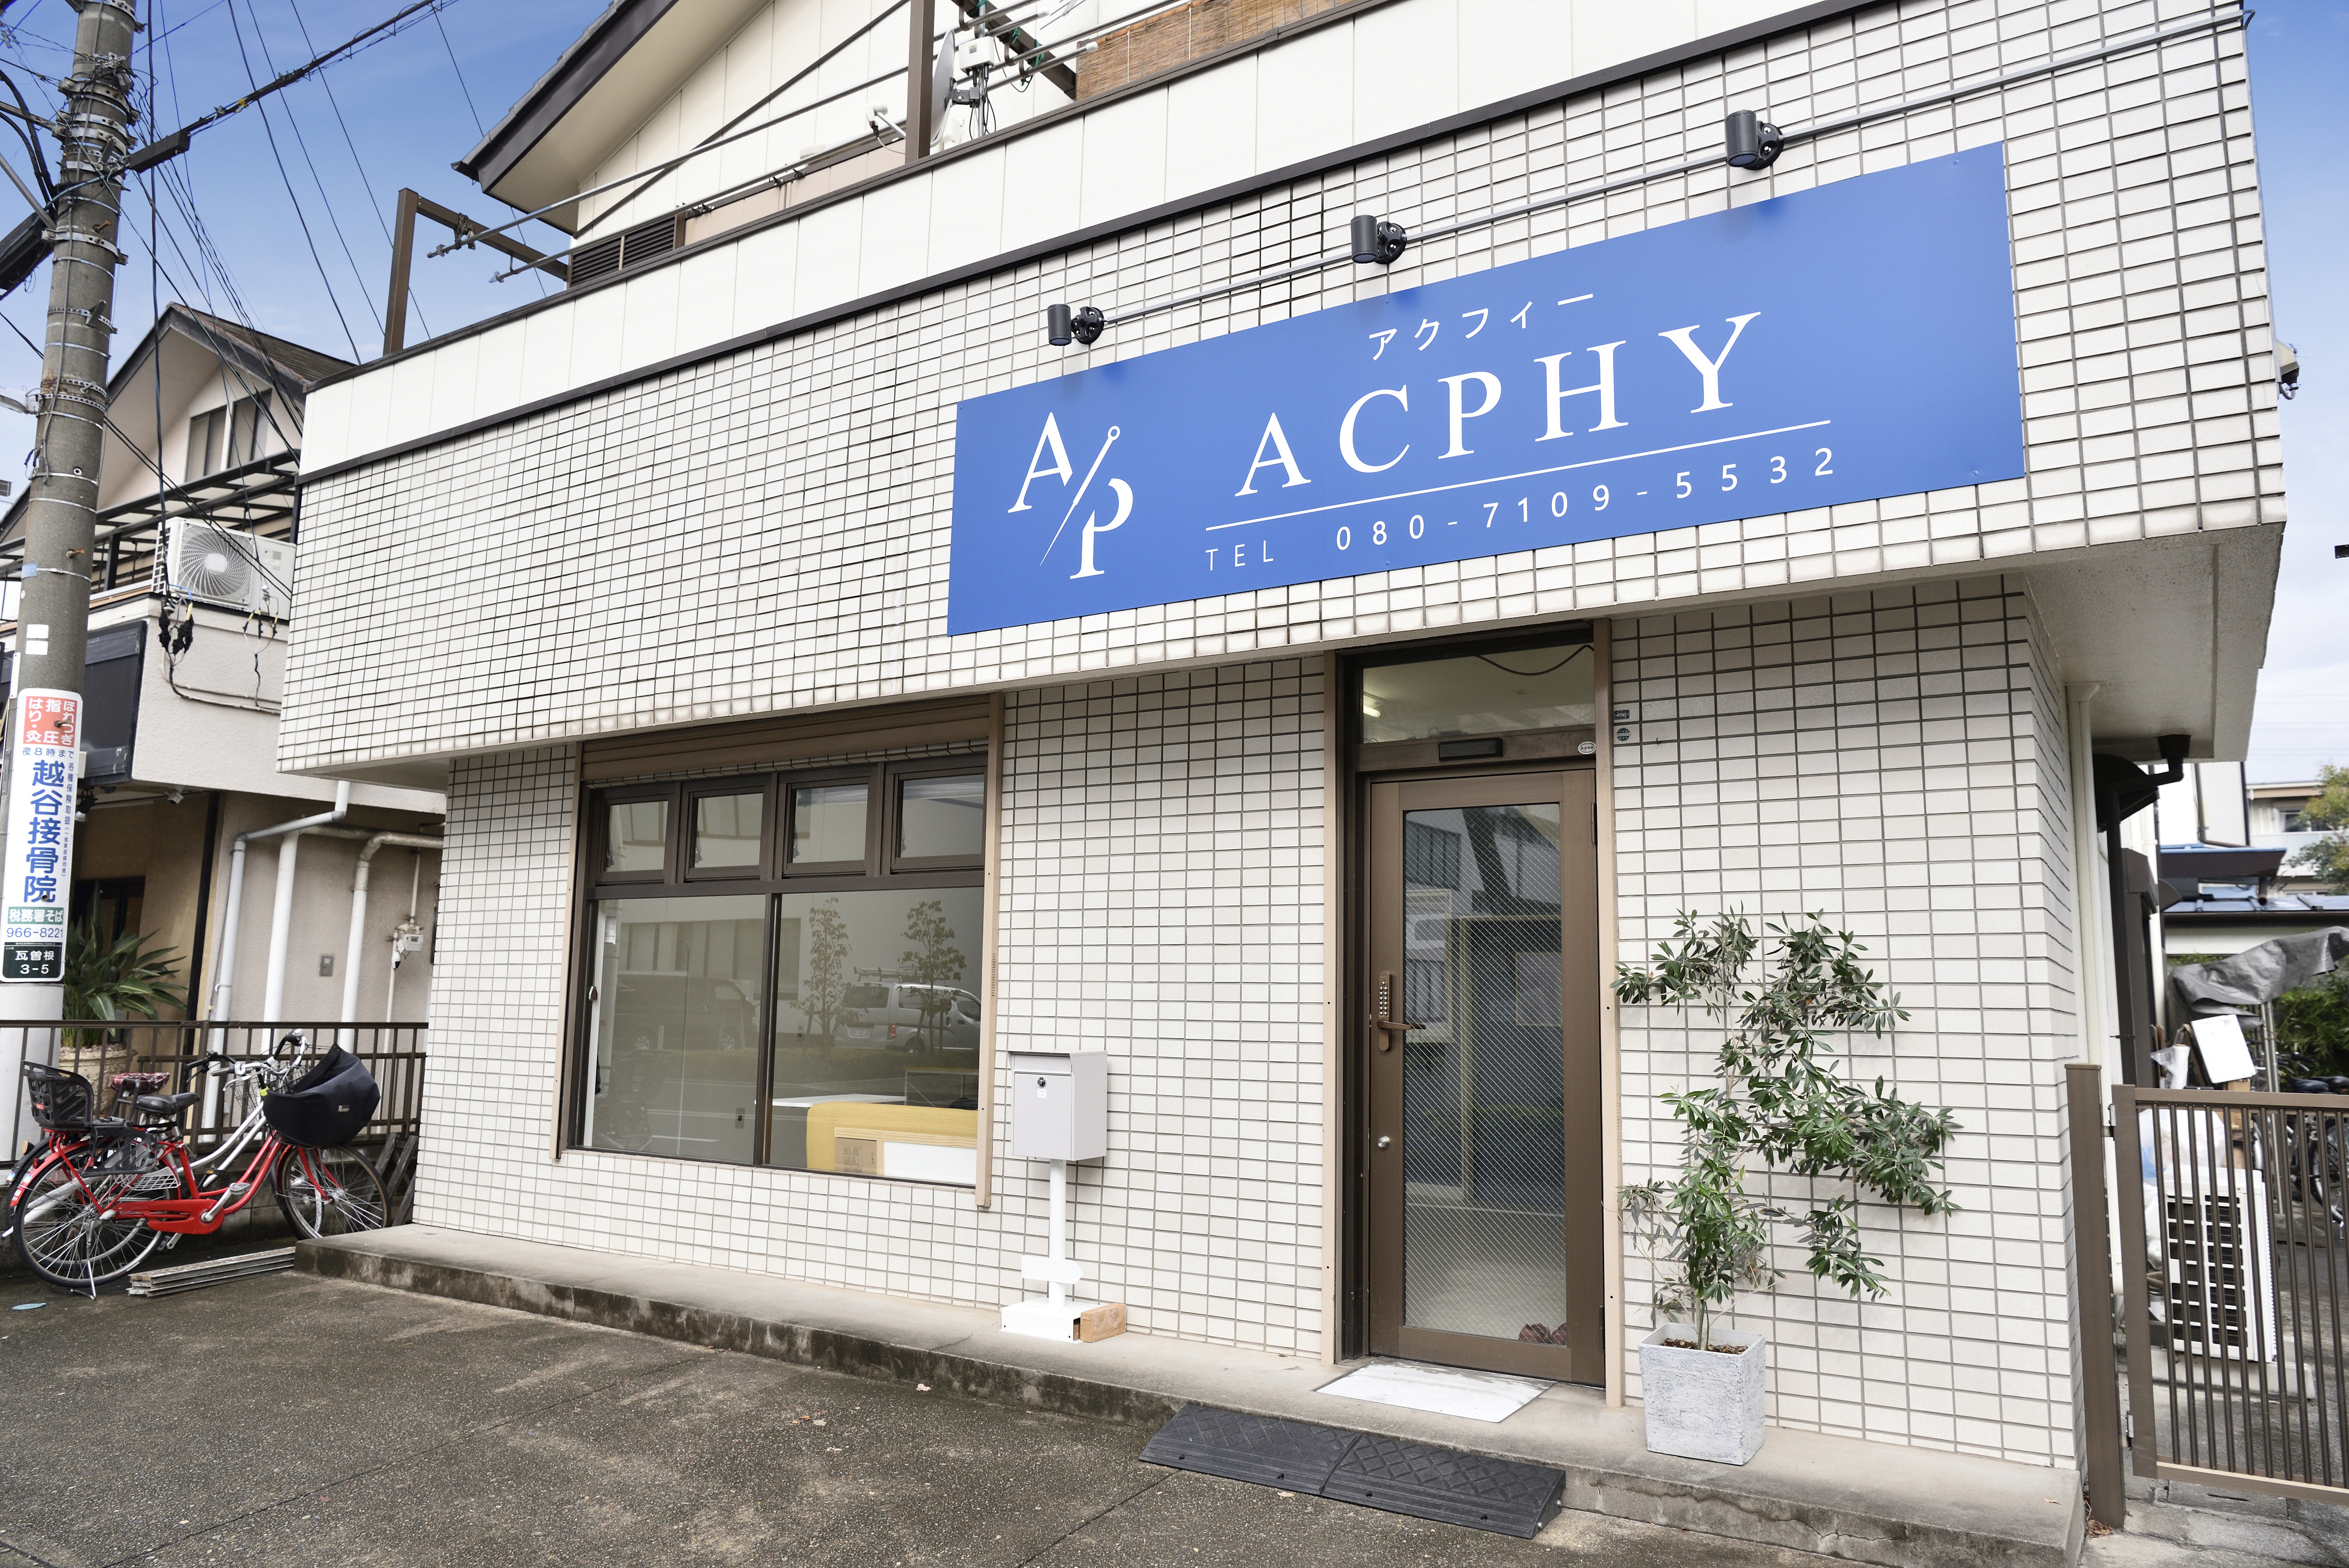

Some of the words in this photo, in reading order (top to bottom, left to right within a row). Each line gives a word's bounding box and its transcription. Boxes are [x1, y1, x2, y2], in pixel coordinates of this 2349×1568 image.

[1369, 293, 1594, 361] アクフィー
[1234, 311, 1762, 497] ACPHY
[1205, 540, 1274, 571] TEL
[1336, 447, 1834, 551] 080-7109-5532
[24, 760, 65, 903] 越谷接骨院
[7, 927, 63, 938] 966-8221
[9, 908, 63, 923] 税務署そば
[20, 964, 49, 974] 3-5
